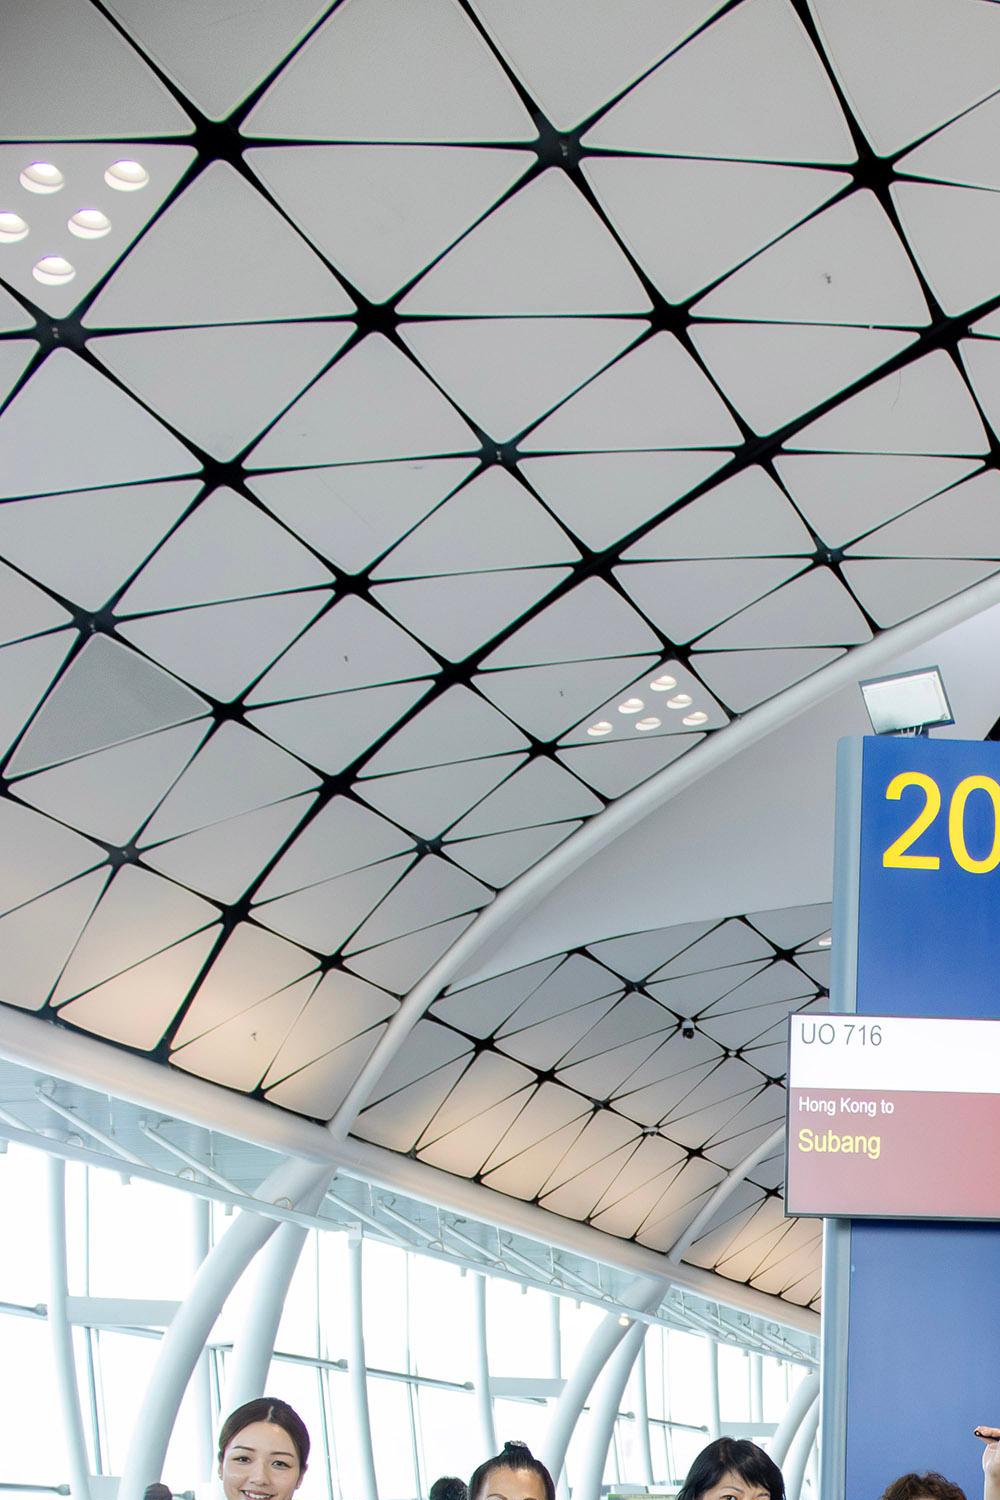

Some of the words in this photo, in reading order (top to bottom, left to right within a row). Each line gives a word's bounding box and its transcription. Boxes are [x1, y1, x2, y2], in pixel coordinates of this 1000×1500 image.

[800, 1022, 836, 1046] UO
[844, 1024, 883, 1047] 716
[798, 1096, 836, 1116] Hong
[840, 1097, 877, 1117] Kong
[880, 1099, 894, 1114] to
[798, 1128, 881, 1160] Subang
